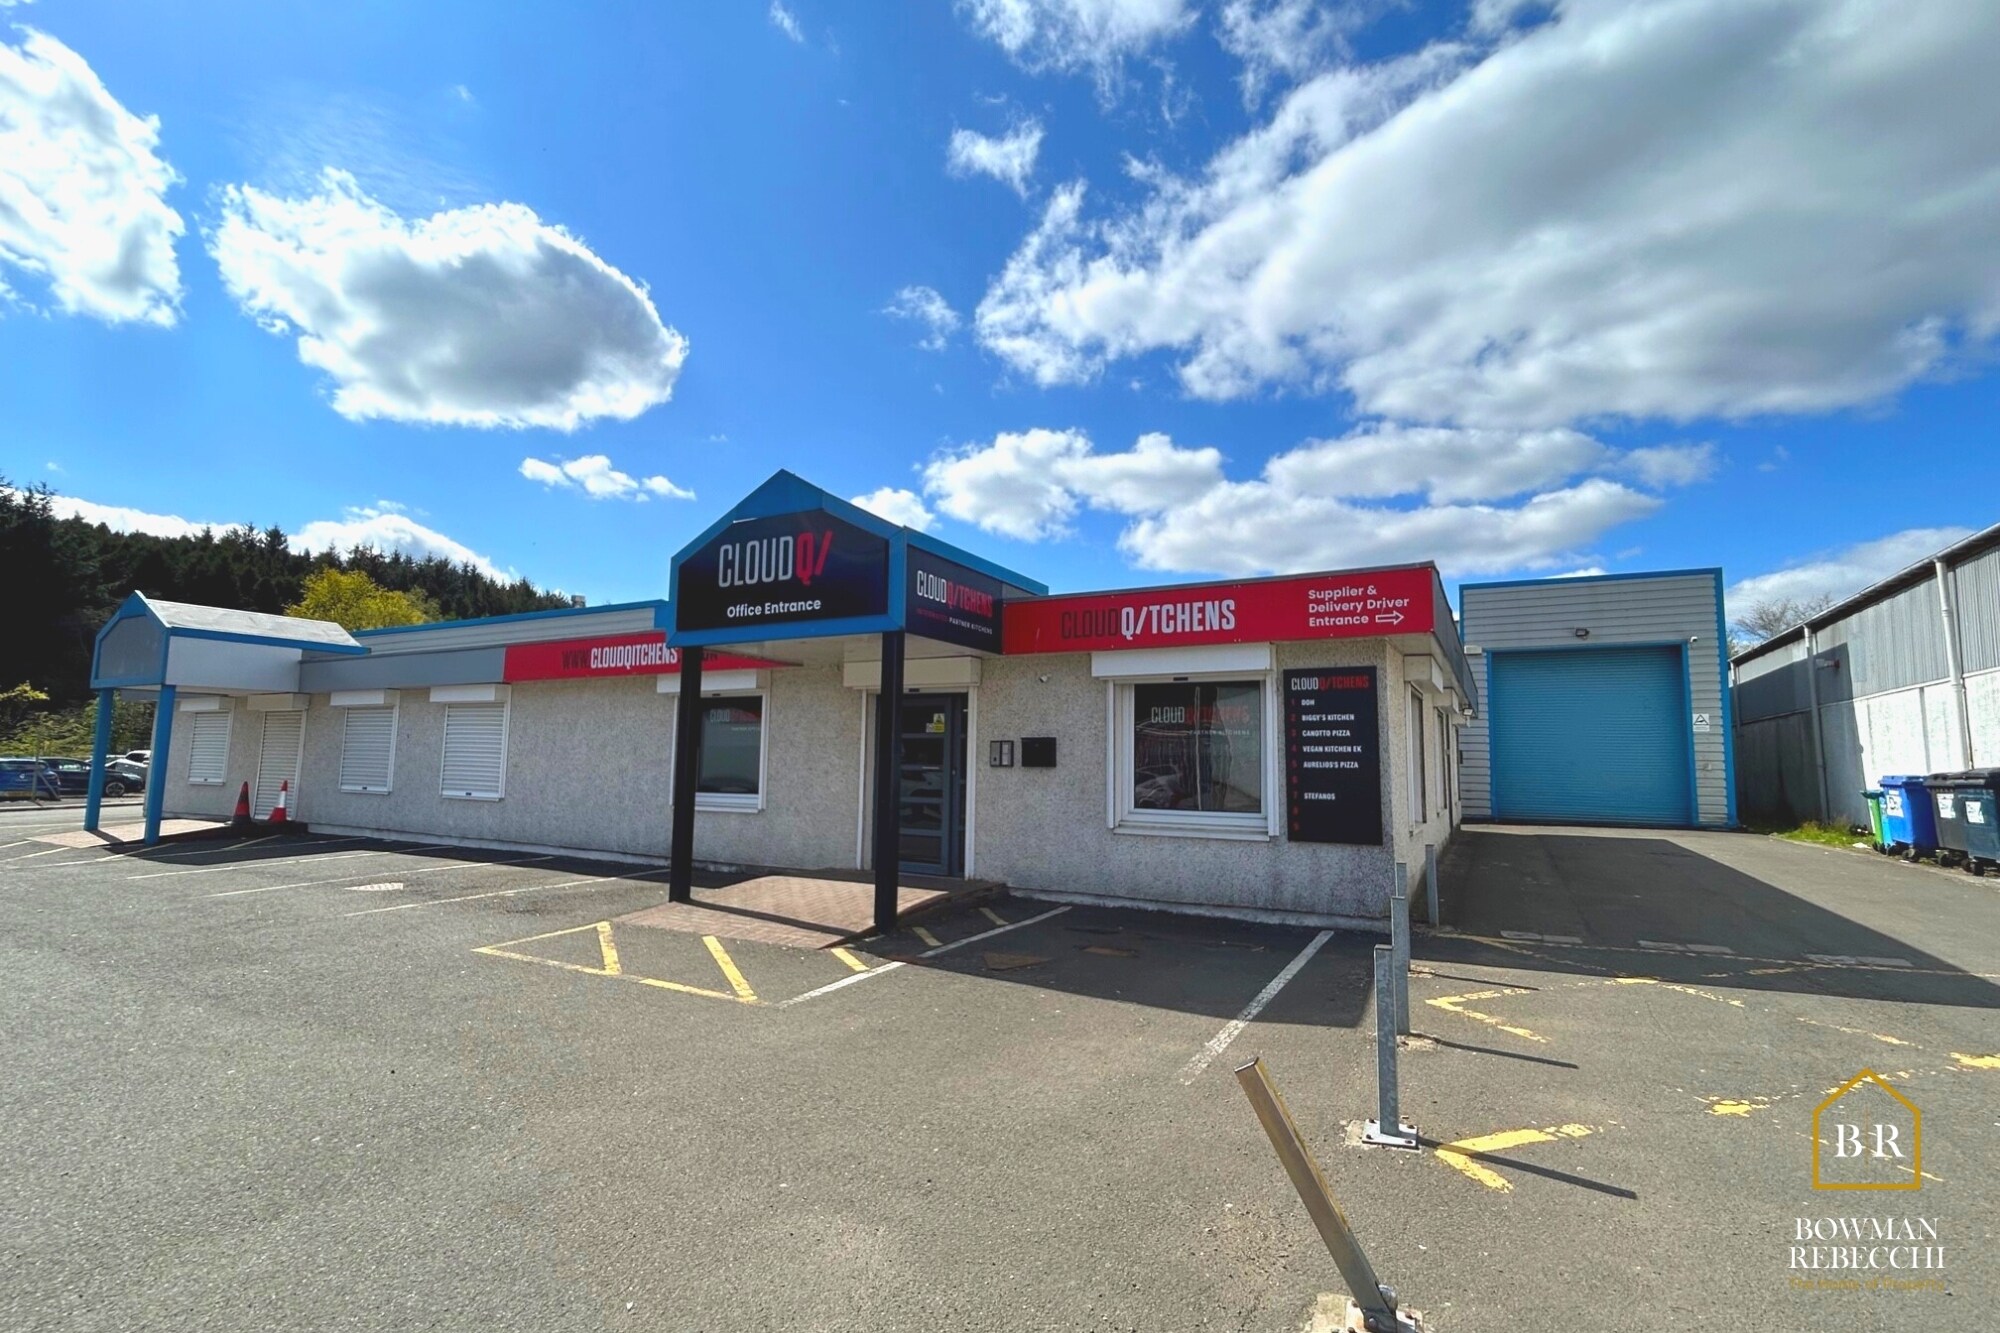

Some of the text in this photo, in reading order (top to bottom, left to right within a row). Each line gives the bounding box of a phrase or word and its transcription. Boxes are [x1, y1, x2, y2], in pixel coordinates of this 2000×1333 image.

[1308, 585, 1378, 601] Supplier &
[727, 598, 821, 618] Office Entrance
[1309, 597, 1410, 613] Delivery Driver
[1309, 615, 1369, 627] Entrance
[1327, 713, 1354, 721] KITCHEN
[1332, 729, 1351, 737] PIZZA
[1302, 745, 1323, 753] VEGAN
[1324, 745, 1352, 753] KITCHEN
[1340, 761, 1359, 769] PIZZA
